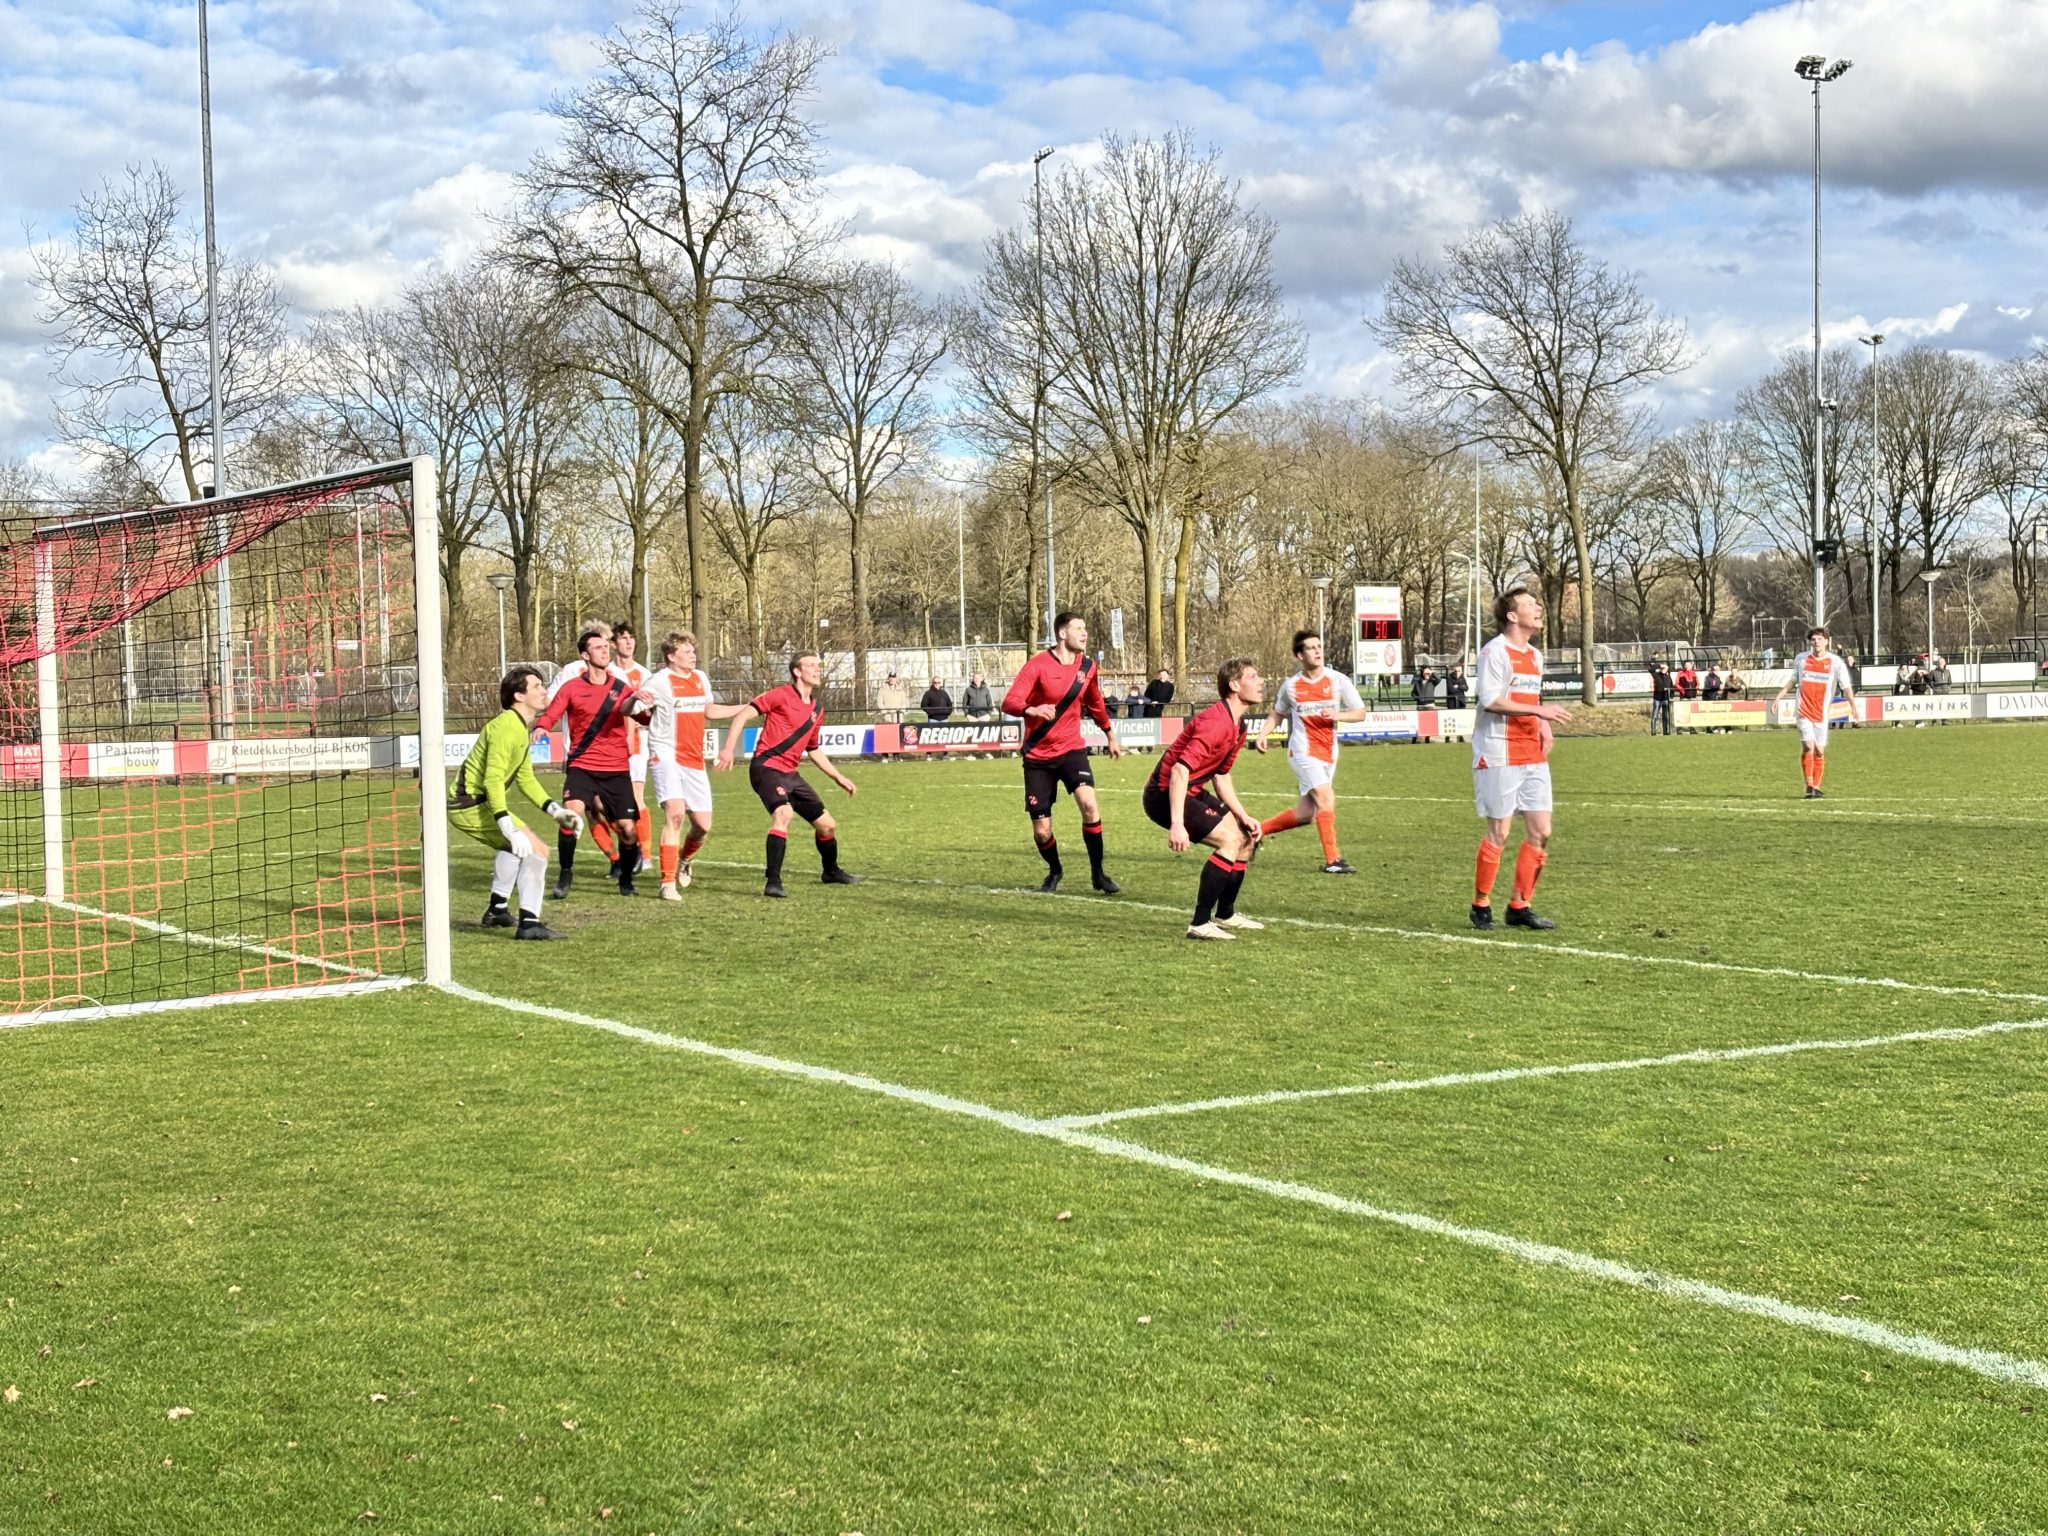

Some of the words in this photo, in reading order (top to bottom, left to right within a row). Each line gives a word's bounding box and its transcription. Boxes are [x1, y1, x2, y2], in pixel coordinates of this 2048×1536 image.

[1884, 701, 1968, 712] BANNINK
[1372, 713, 1407, 722] Wissink
[818, 733, 855, 746] uzen
[919, 726, 1000, 744] REGIOPLAN
[105, 745, 160, 756] Paalman
[232, 743, 329, 756] Rietdekkersbedrijf
[345, 741, 368, 753] KOK
[127, 757, 160, 767] bouw
